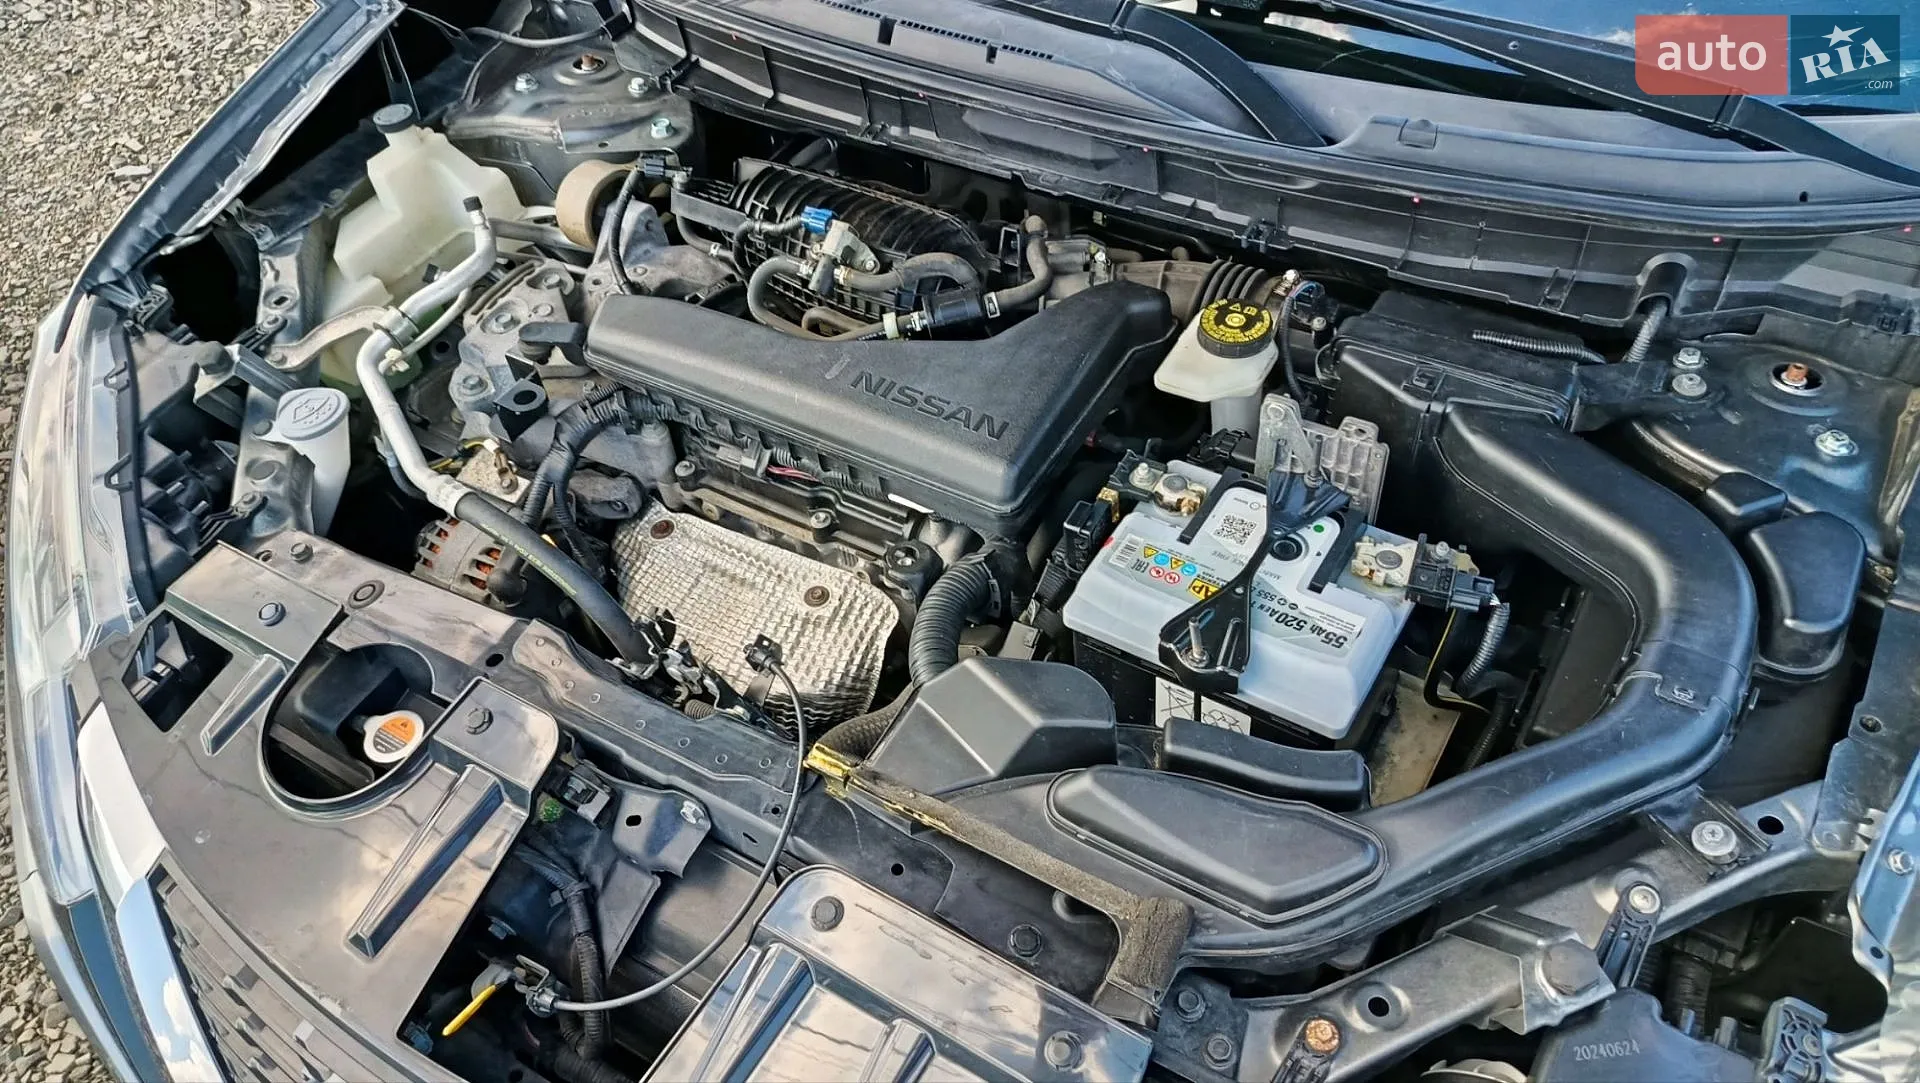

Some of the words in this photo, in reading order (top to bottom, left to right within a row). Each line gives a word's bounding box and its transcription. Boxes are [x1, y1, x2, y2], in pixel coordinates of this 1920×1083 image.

[850, 371, 1010, 441] NISSAN
[1191, 582, 1213, 600] AP
[1309, 624, 1348, 649] 55Ah
[1574, 1039, 1640, 1061] 20240624
